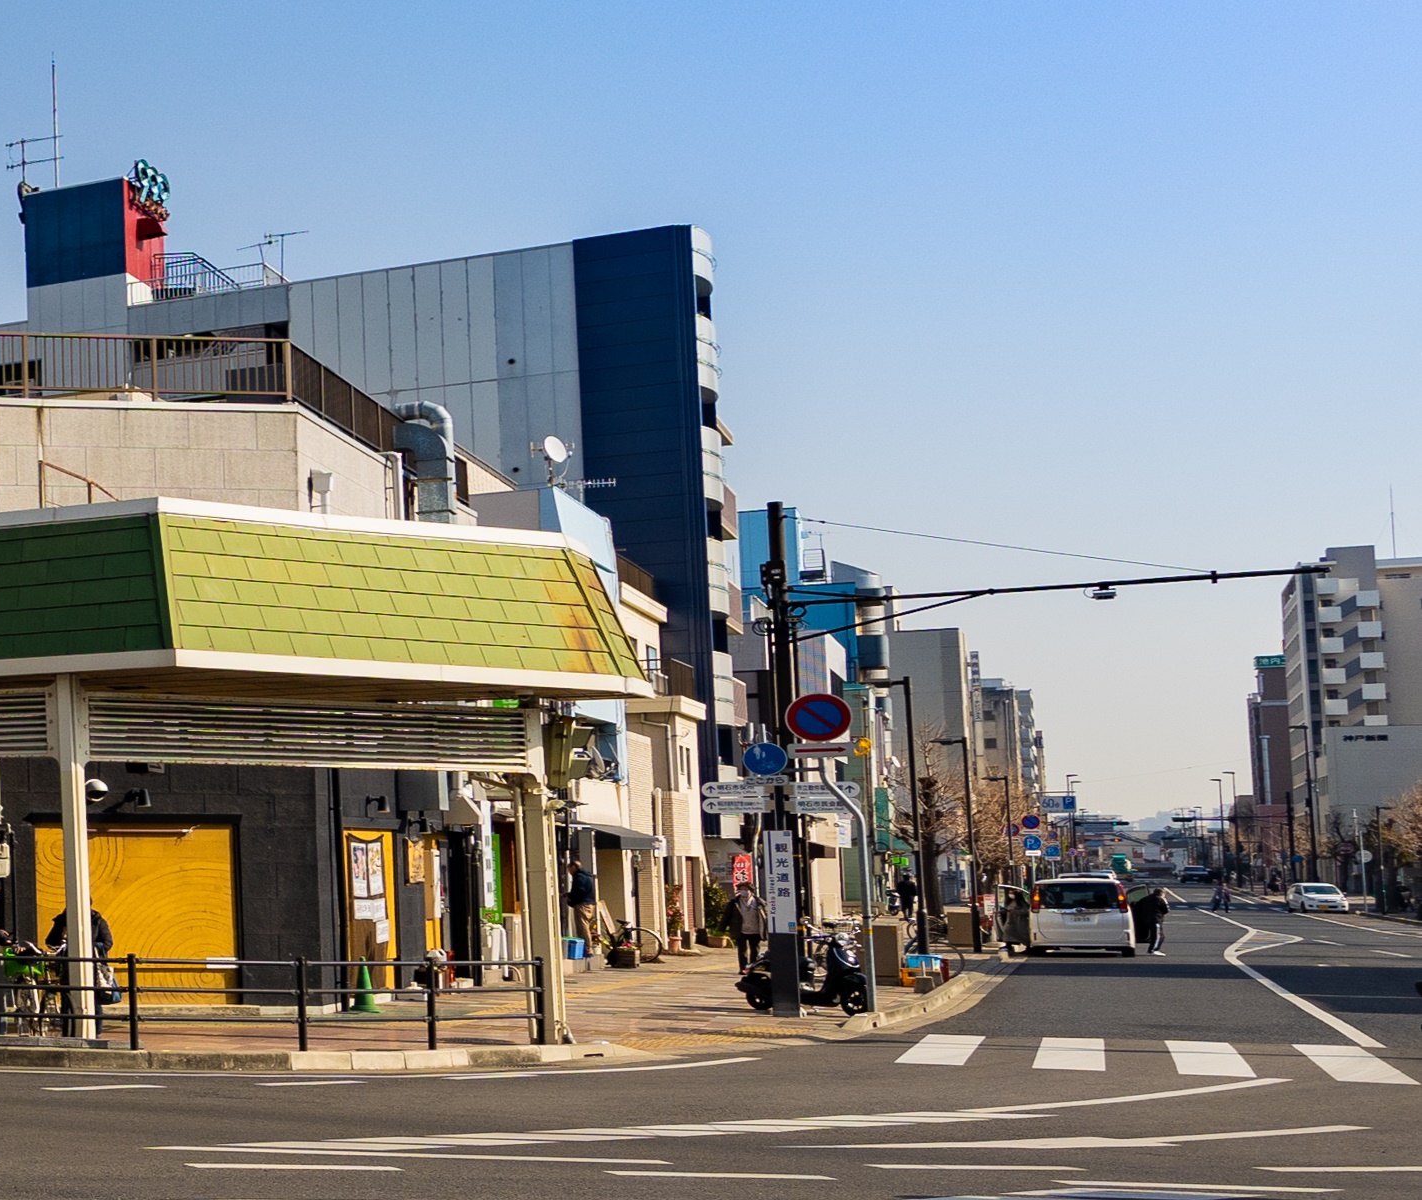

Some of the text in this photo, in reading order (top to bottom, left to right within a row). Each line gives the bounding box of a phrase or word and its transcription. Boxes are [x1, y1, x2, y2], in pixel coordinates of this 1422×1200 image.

[746, 776, 785, 784] ここから
[774, 843, 791, 898] 観光道路
